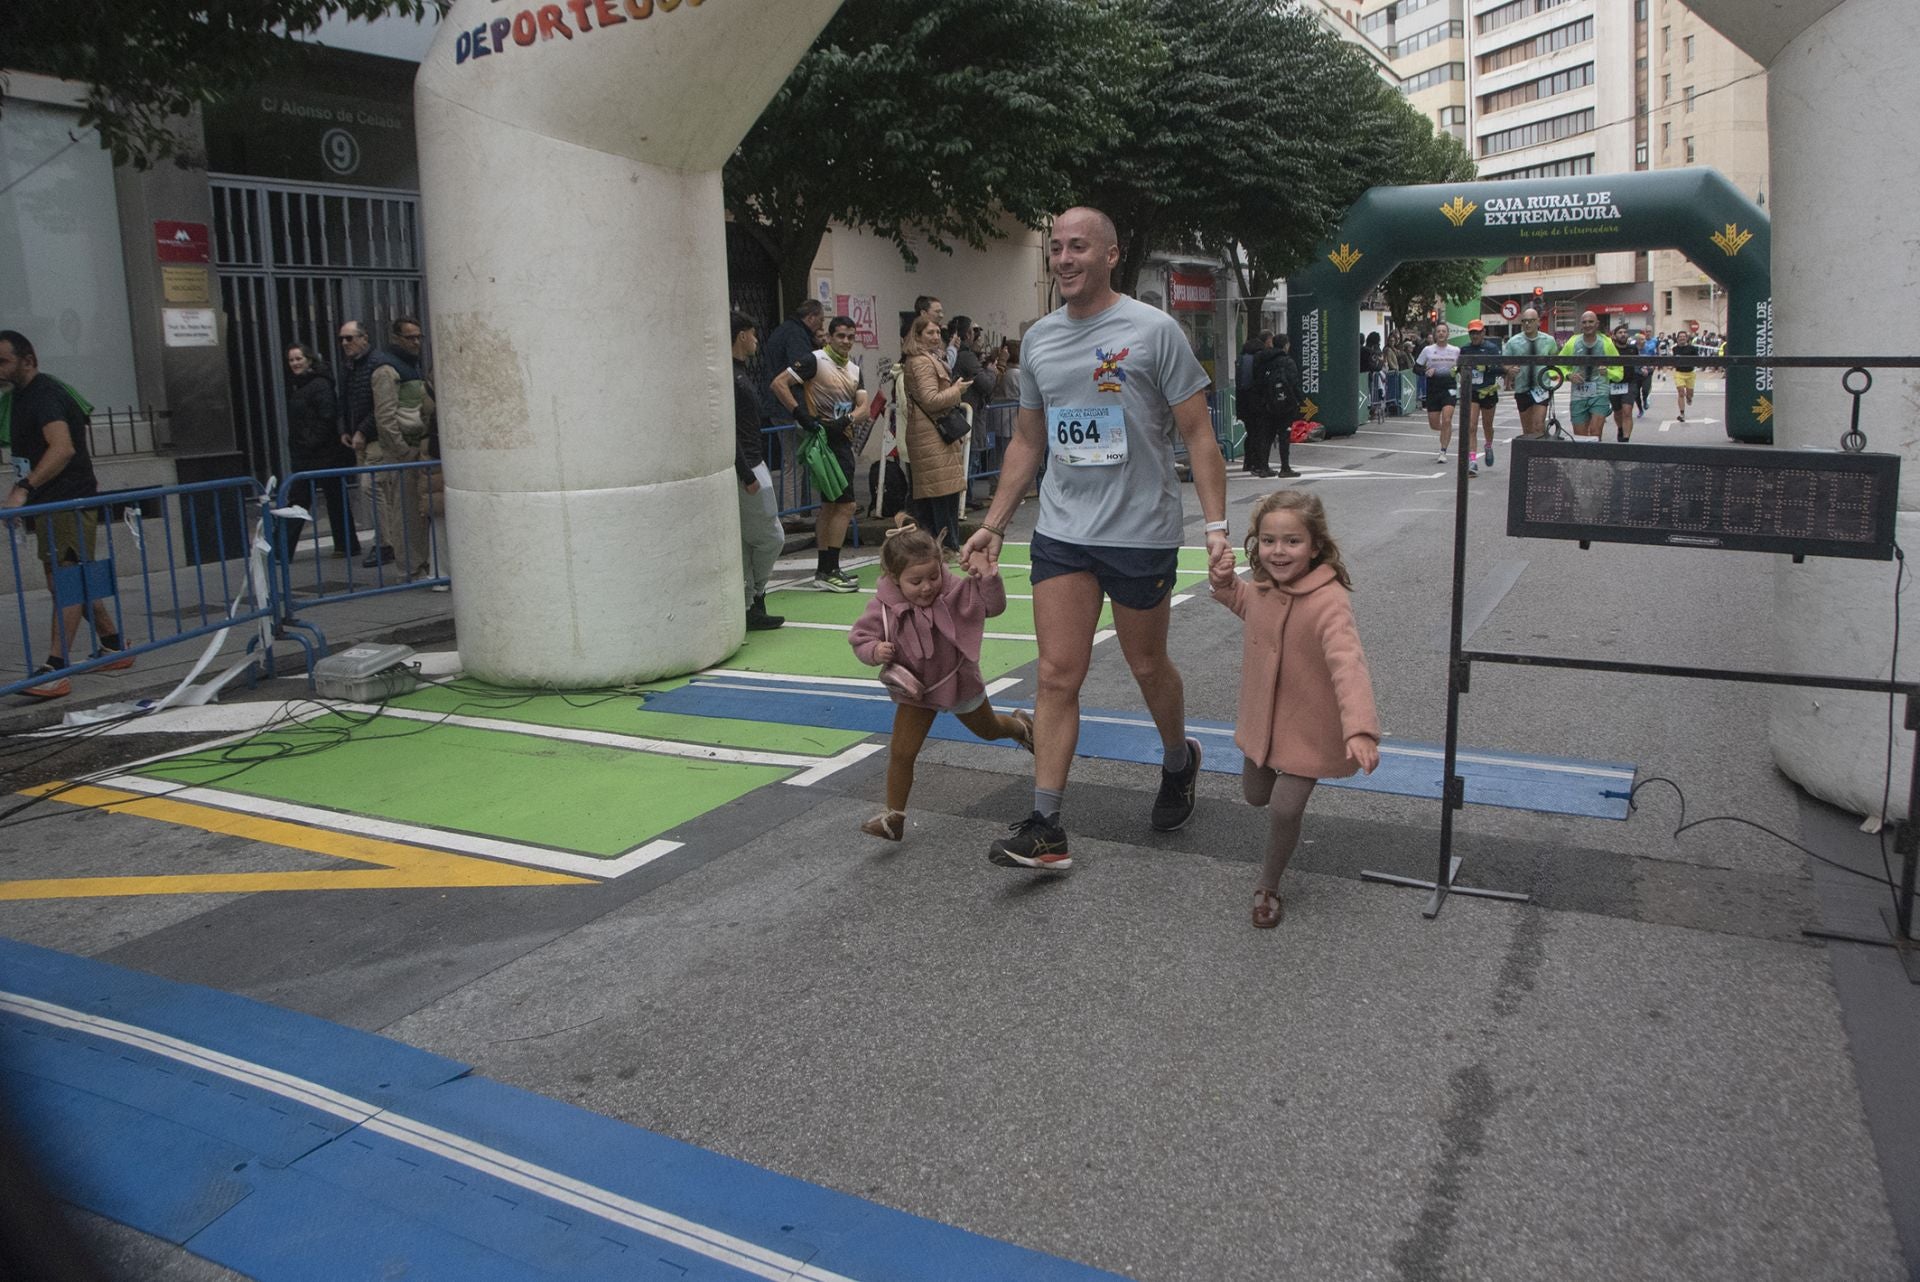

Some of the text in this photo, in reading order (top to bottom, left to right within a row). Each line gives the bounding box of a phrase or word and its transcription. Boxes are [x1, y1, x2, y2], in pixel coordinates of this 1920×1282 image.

[281, 101, 333, 120] Alonso
[337, 110, 354, 123] de
[331, 134, 350, 169] 9
[1484, 191, 1611, 212] CAJA RURAL DE
[1484, 205, 1621, 226] EXTREMADURA
[1551, 227, 1560, 236] de
[1563, 225, 1618, 236] Extremadura
[853, 306, 873, 328] 24
[1756, 301, 1767, 319] DE
[1302, 314, 1310, 393] CAJA RURAL DE
[1310, 308, 1319, 393] EXTREMADURA
[1057, 420, 1100, 444] 664
